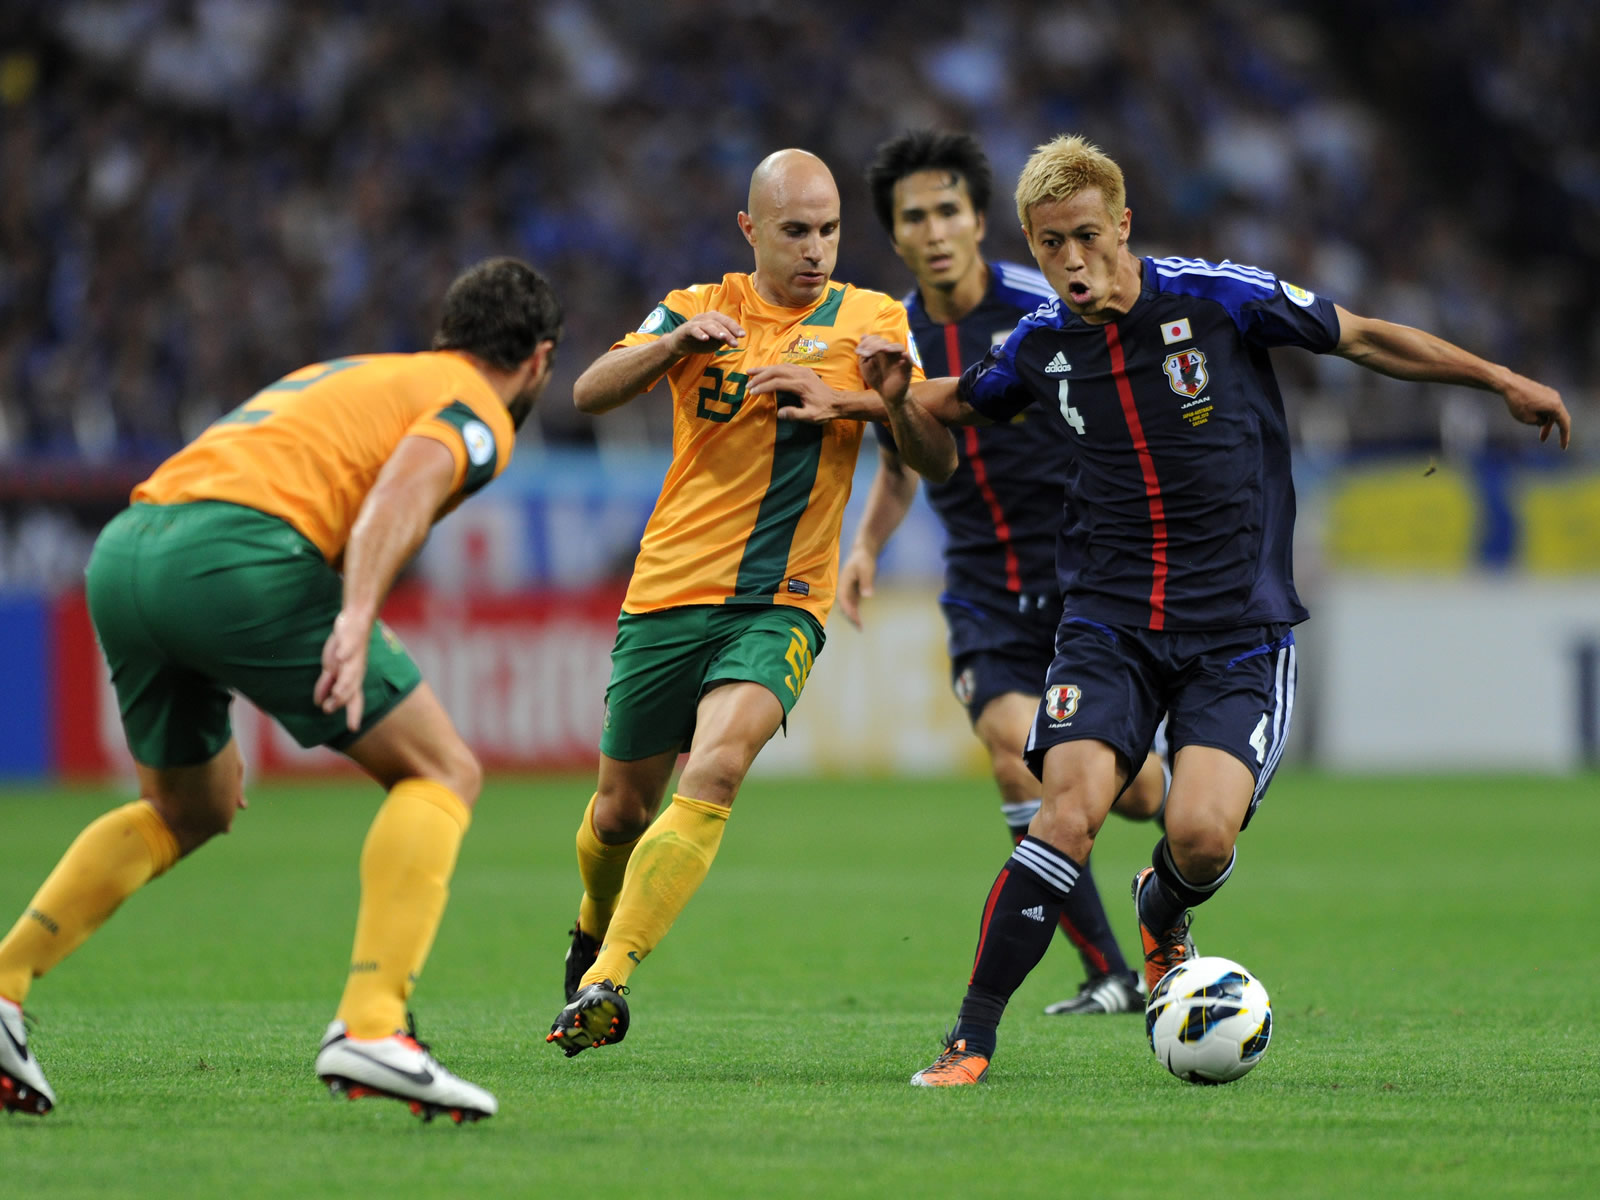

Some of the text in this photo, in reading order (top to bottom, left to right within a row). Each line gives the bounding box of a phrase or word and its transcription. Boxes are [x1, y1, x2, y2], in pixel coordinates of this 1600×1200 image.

[696, 366, 750, 424] 23
[1044, 364, 1072, 374] adidas
[1058, 379, 1086, 435] 4
[1181, 396, 1210, 410] JAPAN
[1248, 712, 1268, 765] 4
